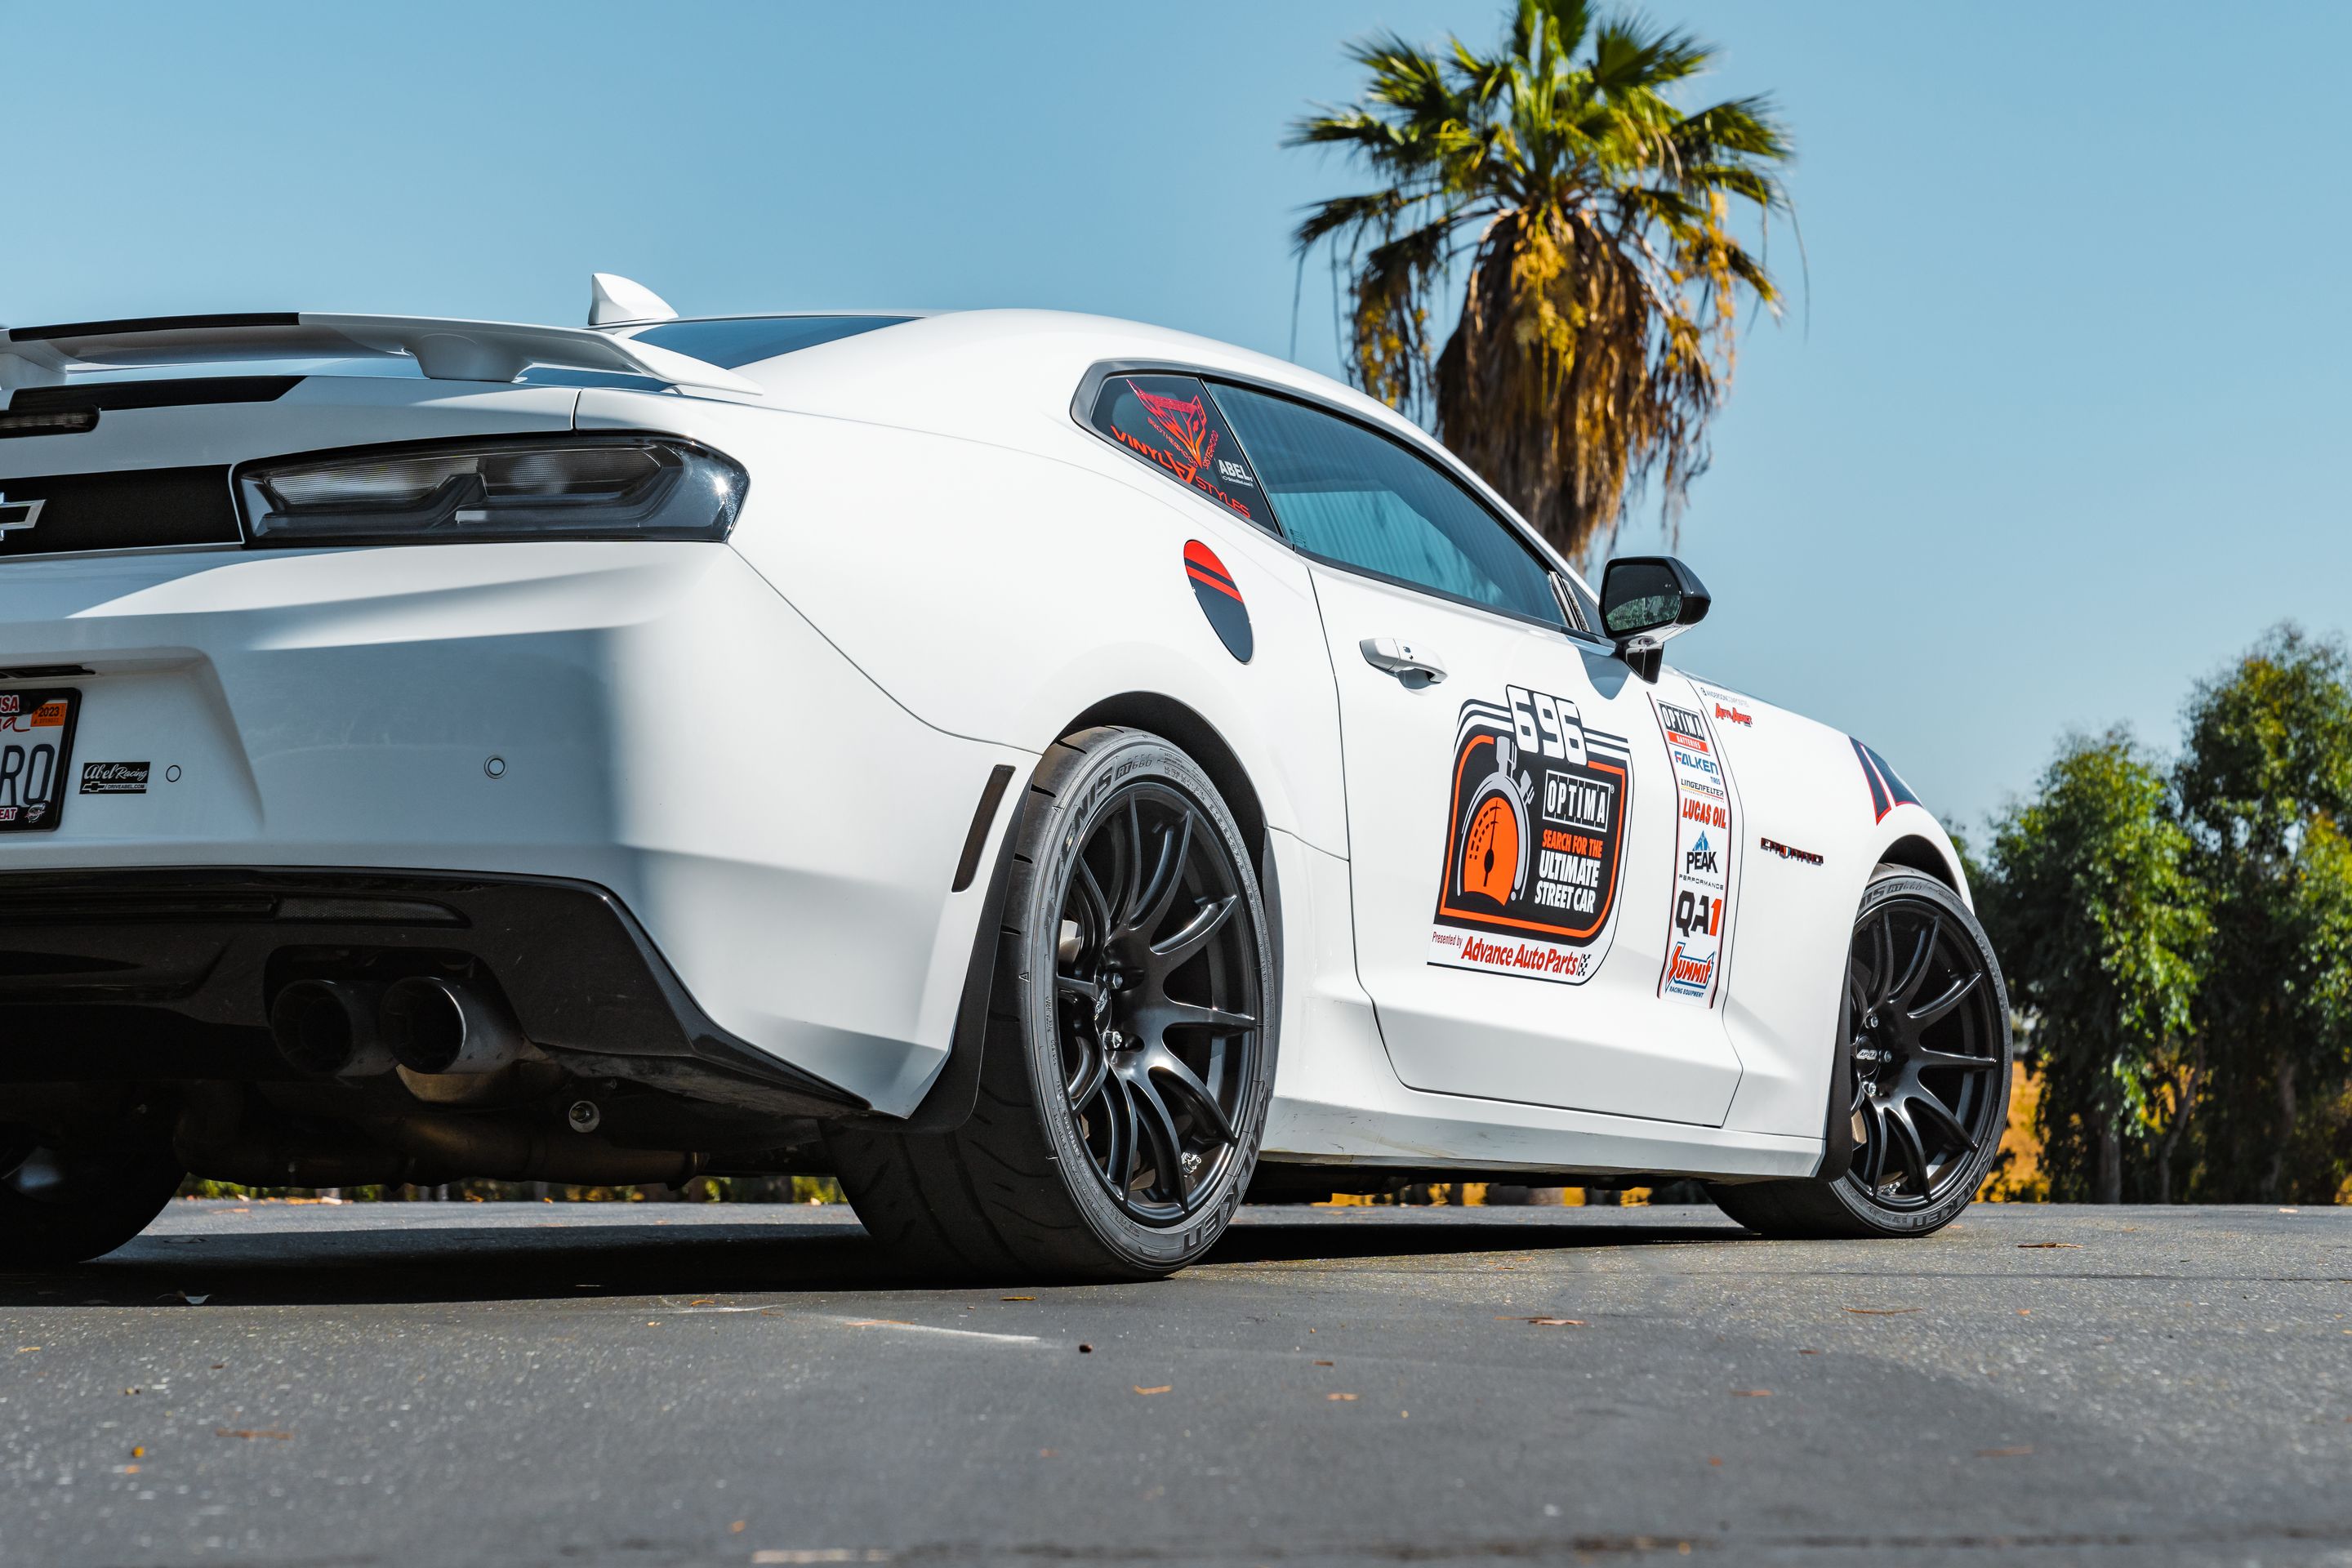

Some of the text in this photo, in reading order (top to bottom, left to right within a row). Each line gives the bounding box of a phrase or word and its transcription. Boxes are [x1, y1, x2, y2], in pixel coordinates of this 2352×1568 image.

[1147, 416, 1198, 468] BROTHERHOOD
[1202, 430, 1218, 470] SISTERHOOD
[1111, 425, 1251, 519] VINYL STYLES
[38, 706, 60, 717] 2023
[1506, 685, 1587, 766] 696
[1660, 705, 1704, 739] OPTIMA
[1677, 734, 1701, 750] BATTERIES
[84, 764, 148, 782] Abel Racing
[1674, 751, 1719, 775] FALKEN
[1547, 779, 1606, 824] OPTIMA
[1681, 778, 1724, 797] LINGENFELTER
[1682, 797, 1726, 829] LUCAS OIL
[1542, 829, 1603, 858] SEARCH FOR THE
[1539, 849, 1601, 888] ULTIMATE
[1686, 852, 1718, 874] PEAK
[1534, 880, 1597, 913] STREET CAR
[1679, 874, 1724, 890] PERFORMANCE
[1676, 889, 1722, 938] QA1
[1432, 931, 1579, 975] Presented by Advance Auto Parts
[1669, 986, 1704, 998] RACING EQUIPMENT
